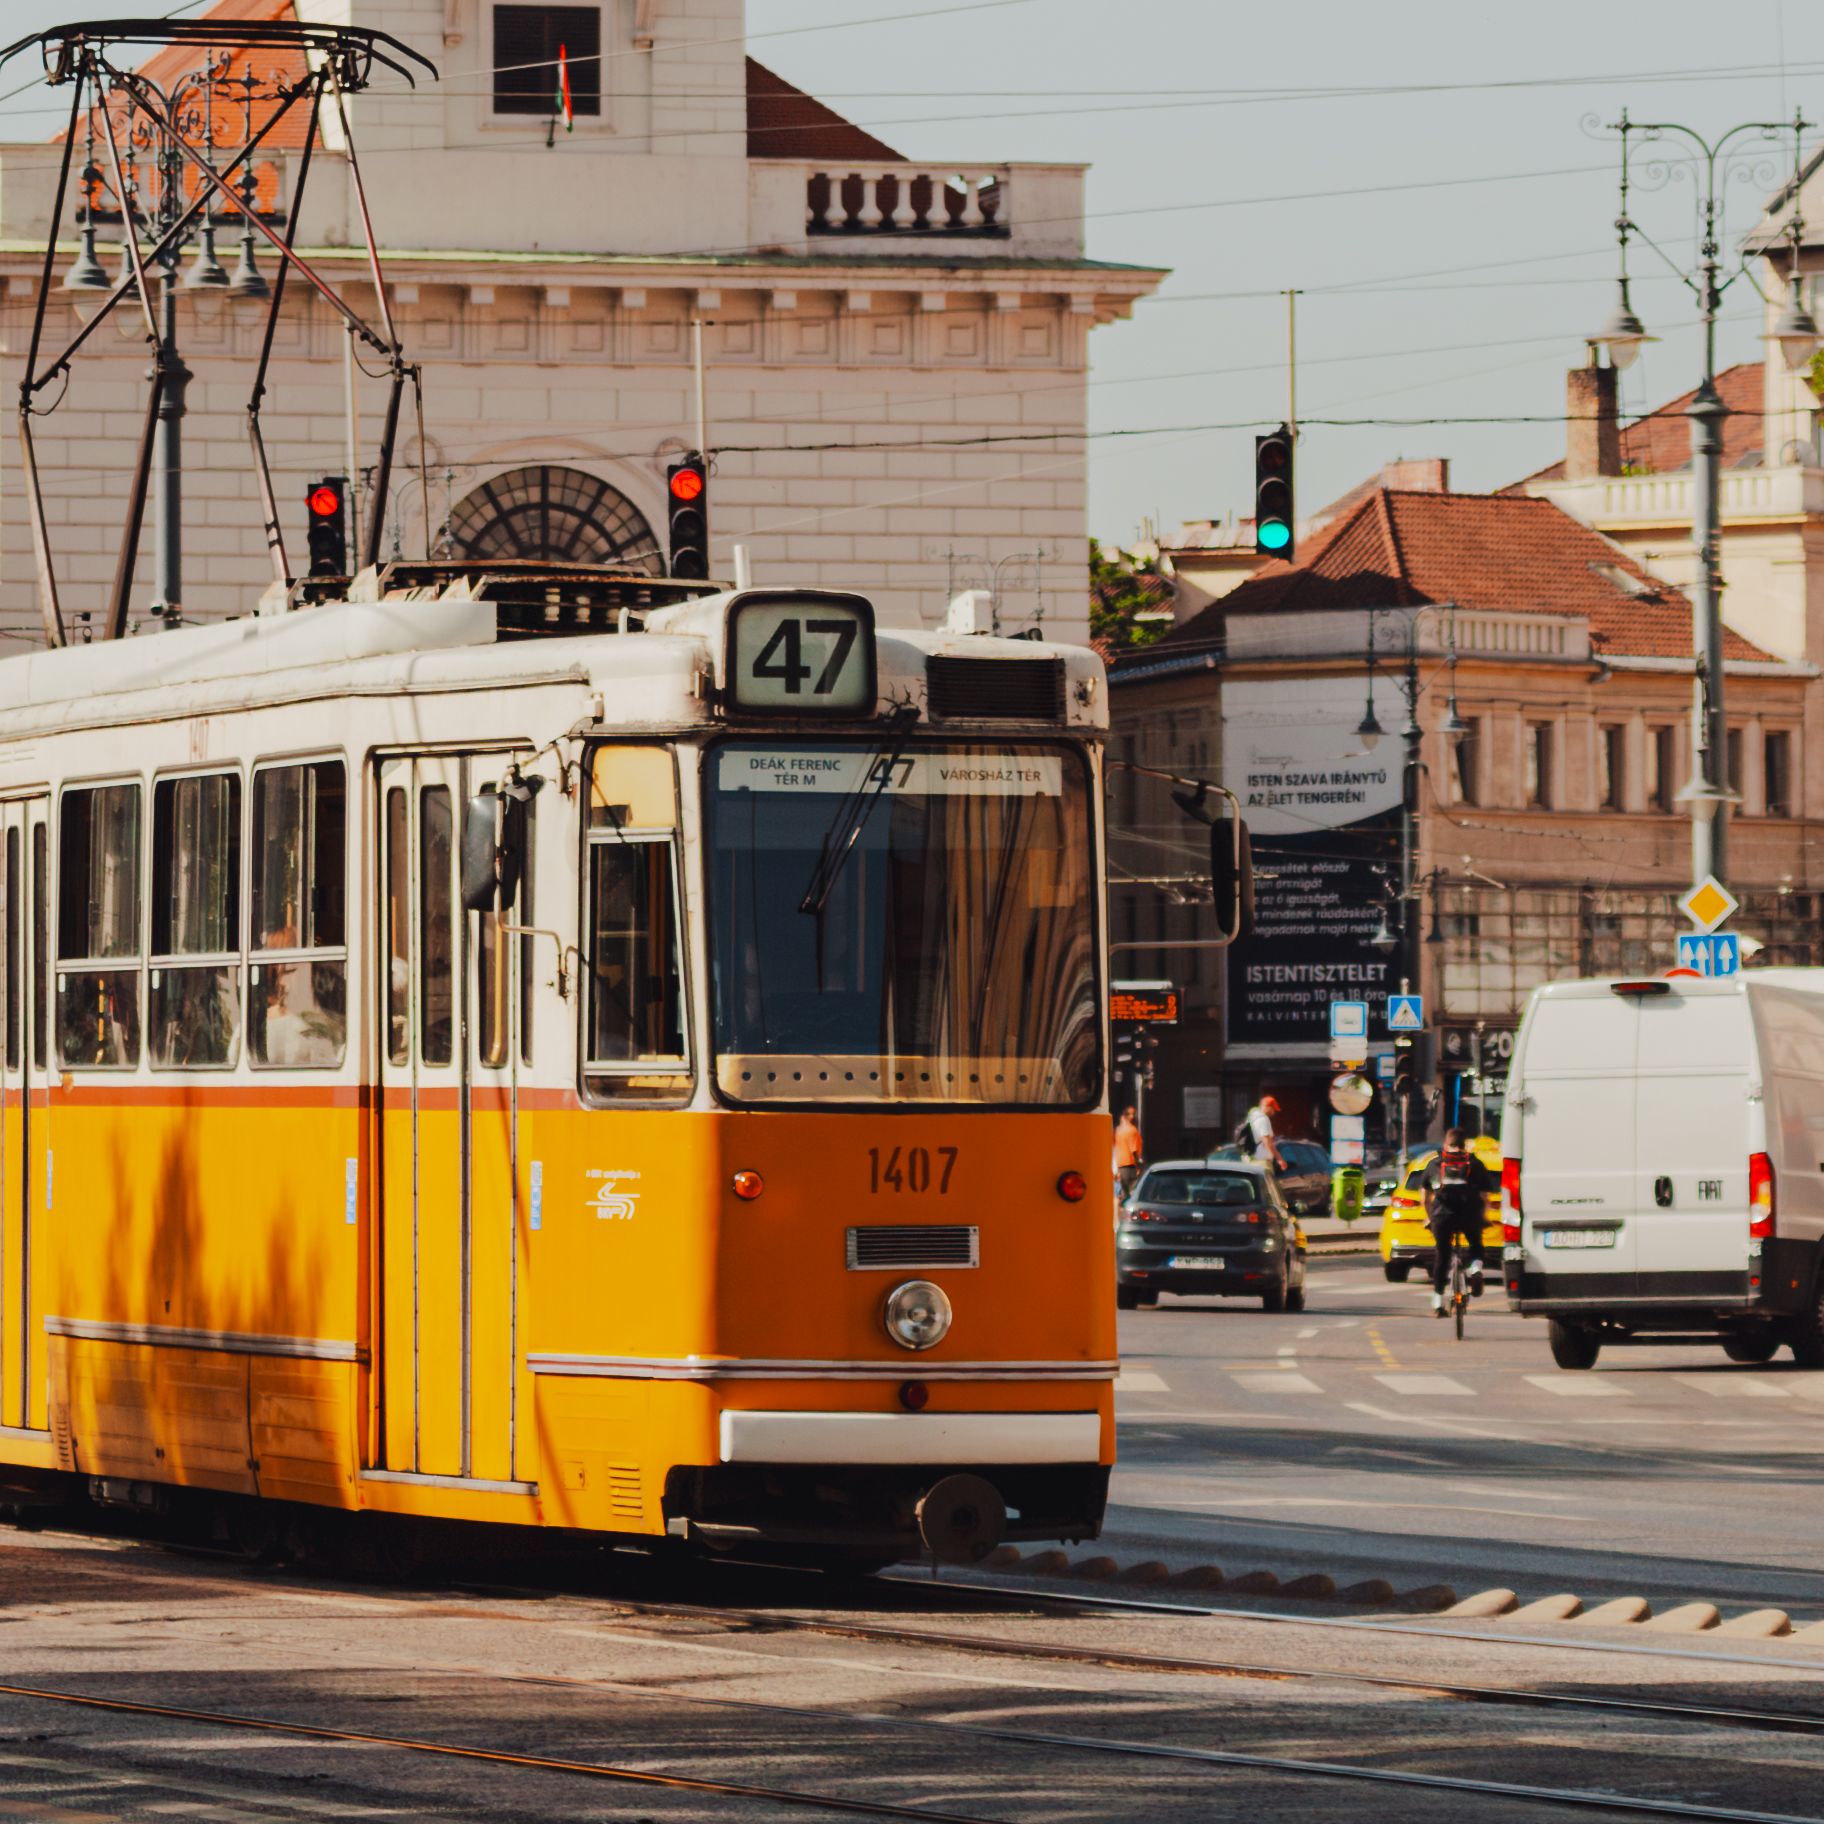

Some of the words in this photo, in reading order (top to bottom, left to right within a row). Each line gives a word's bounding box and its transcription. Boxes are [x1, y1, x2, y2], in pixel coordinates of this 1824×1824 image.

[753, 619, 857, 694] 47
[750, 756, 785, 771] DEÁK
[790, 759, 841, 772] FERENC
[869, 758, 915, 788] 47
[774, 772, 801, 786] TÉR
[803, 775, 817, 786] M
[940, 766, 1013, 782] VÁROSHÁZ
[1016, 768, 1041, 782] TÉR
[1248, 774, 1283, 788] ISTEN
[1286, 773, 1327, 787] SZAVA
[1248, 793, 1264, 806] AZ
[1268, 790, 1293, 805] ÉLET
[1297, 788, 1366, 805] TENGERÉN!
[1246, 964, 1387, 983] ISTENTISZTELET
[1248, 988, 1311, 1005] vasárnap
[1314, 989, 1326, 1001] 10
[1348, 989, 1361, 1002] 18
[1364, 987, 1387, 1001] óra
[868, 1146, 959, 1194] 1407
[1697, 1180, 1724, 1201] FIAT
